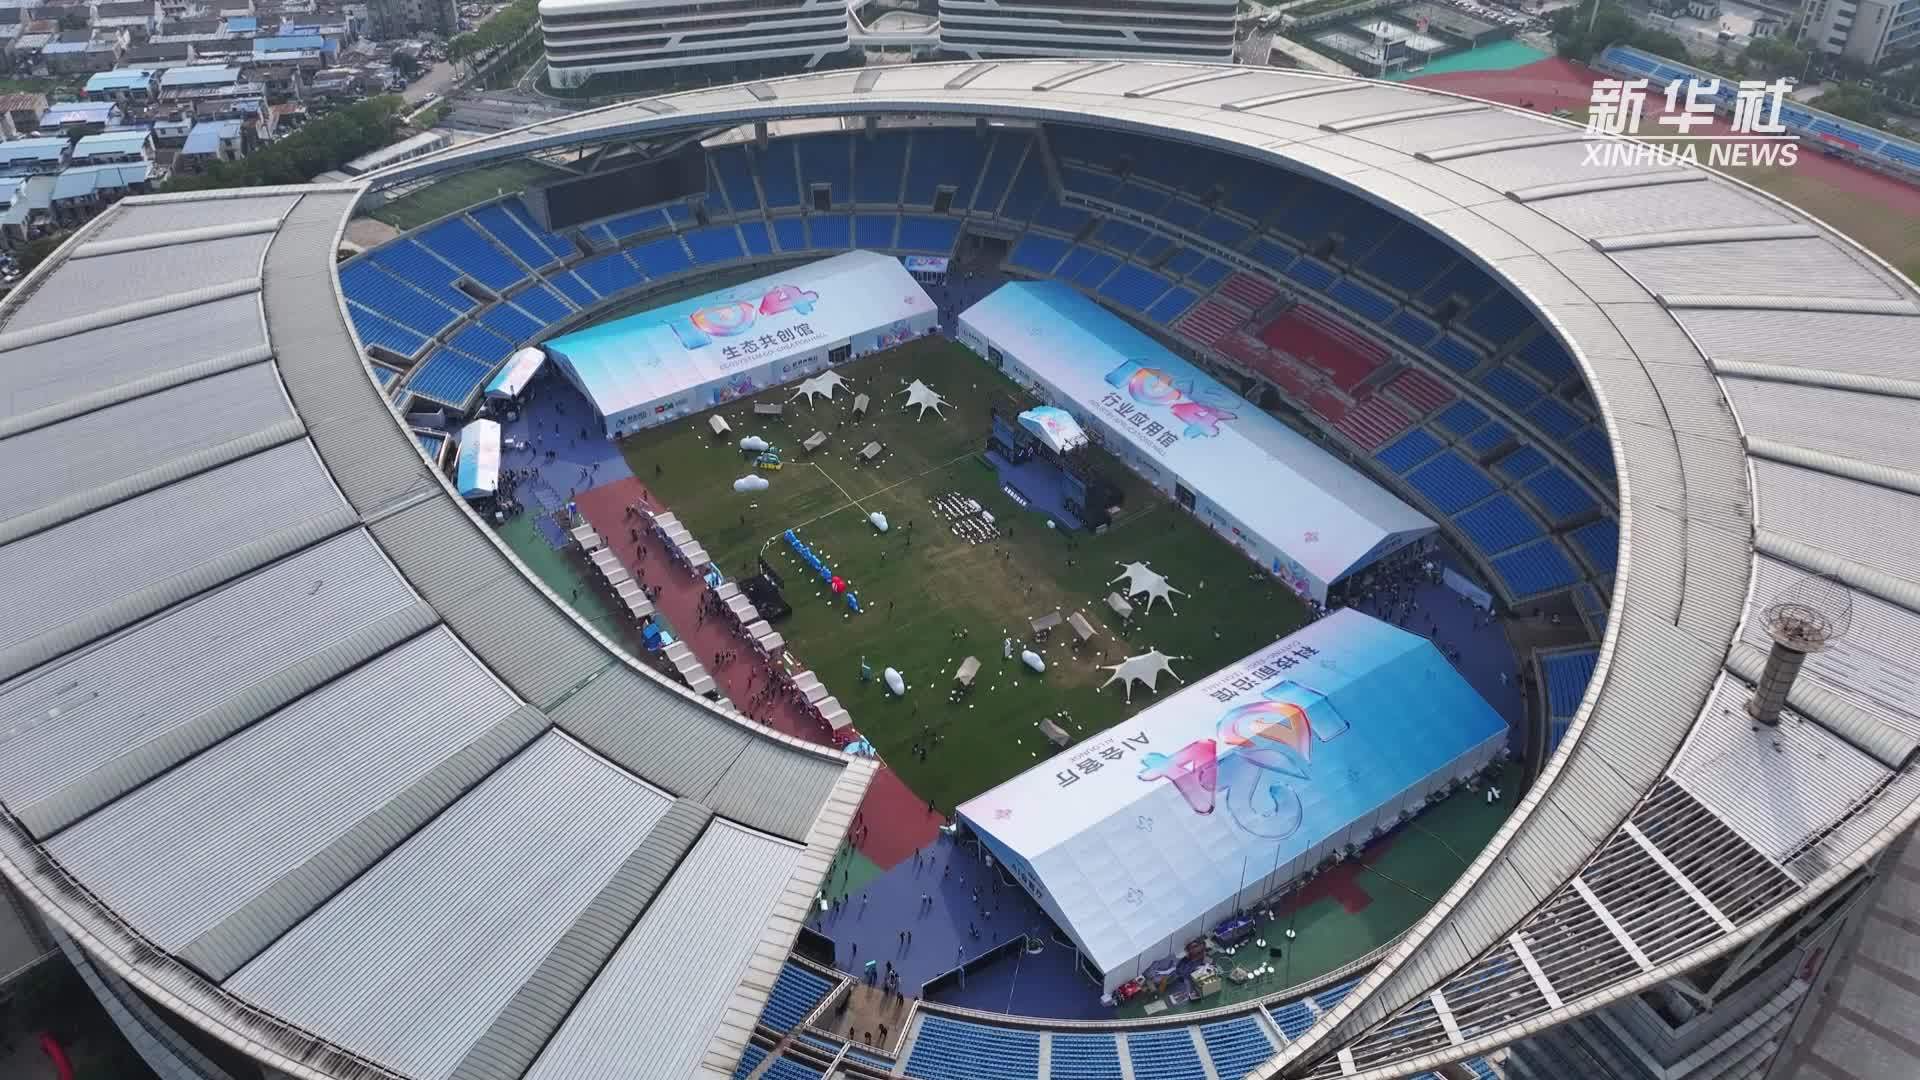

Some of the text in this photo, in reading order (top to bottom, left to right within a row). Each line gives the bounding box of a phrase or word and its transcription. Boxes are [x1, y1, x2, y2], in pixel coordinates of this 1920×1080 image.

[722, 322, 814, 359] 生态共创馆
[1101, 392, 1178, 447] 行业应用馆
[1210, 646, 1320, 702] 科技前沿馆
[1056, 731, 1149, 788] AI会客厅
